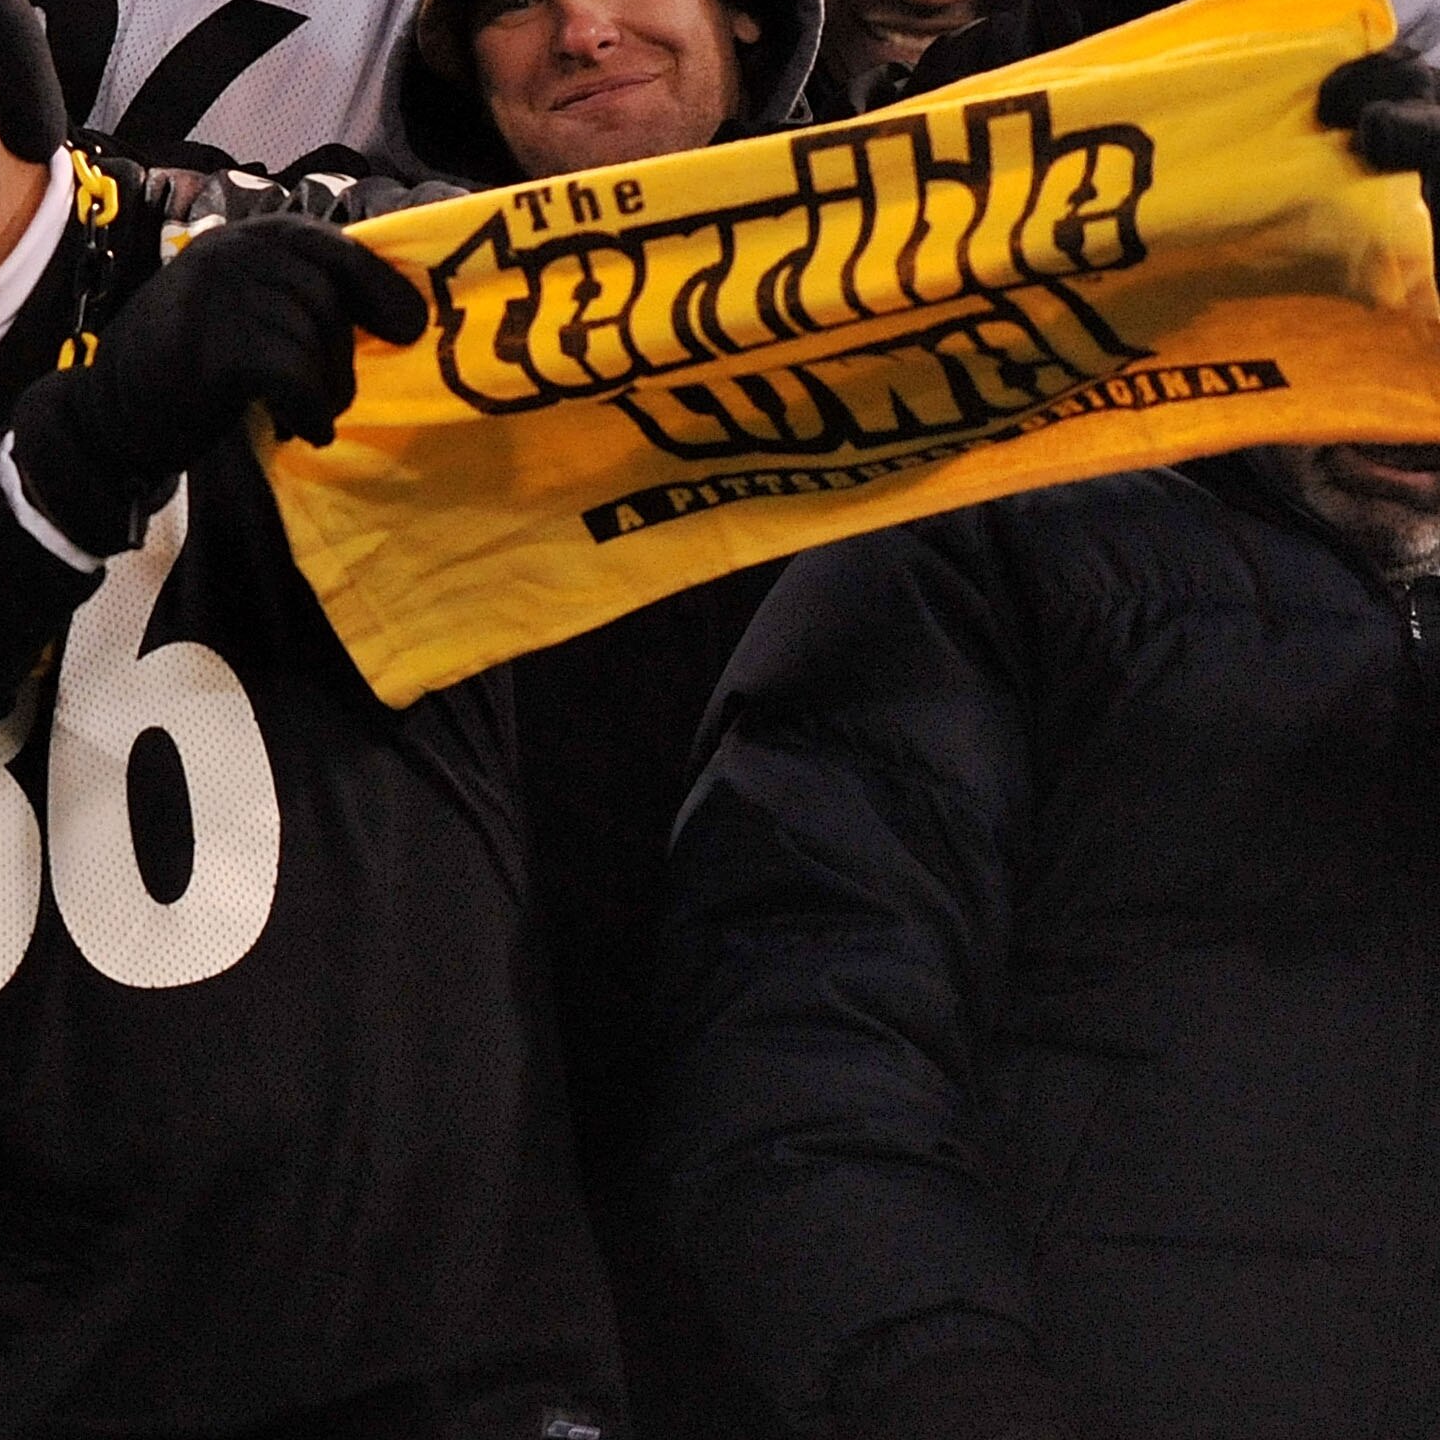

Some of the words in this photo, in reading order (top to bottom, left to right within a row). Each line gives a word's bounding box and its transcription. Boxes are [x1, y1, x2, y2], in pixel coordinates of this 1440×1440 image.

[429, 90, 1156, 415] terrible
[513, 174, 646, 234] The
[597, 282, 1158, 460] towel
[615, 503, 646, 532] A
[666, 440, 991, 516] PITTSB
